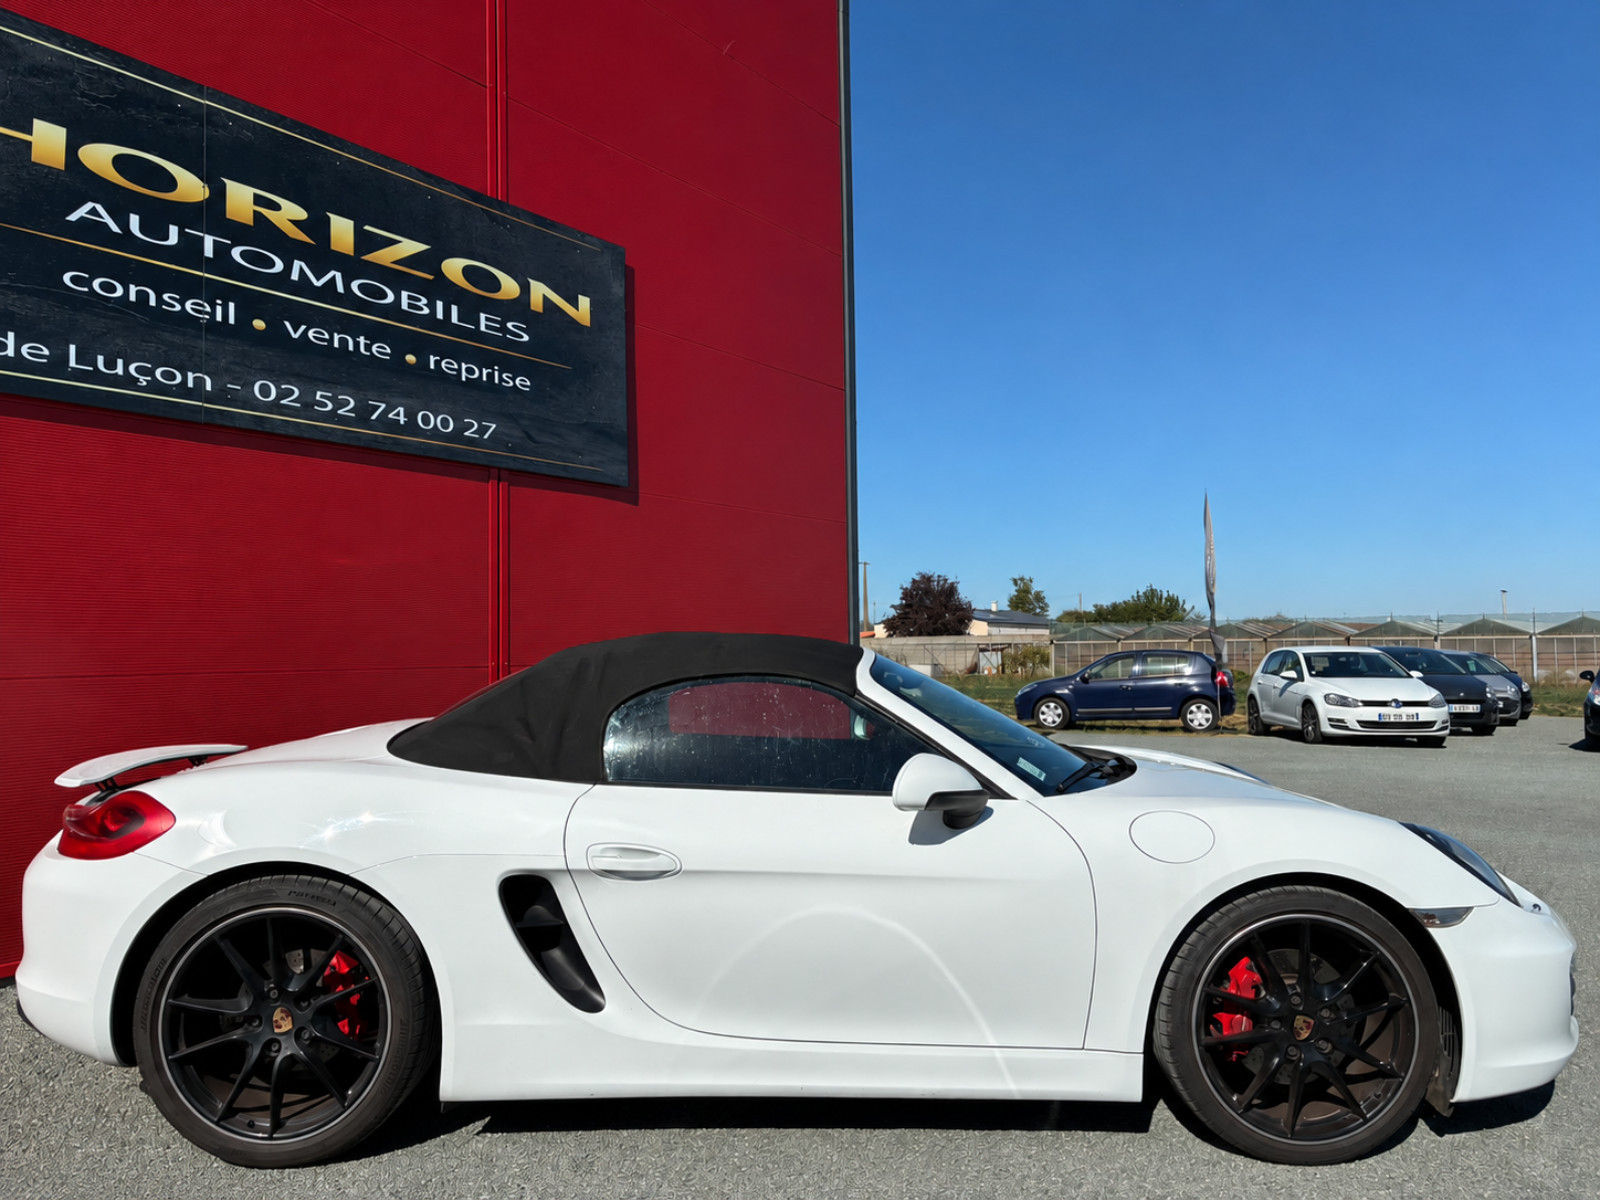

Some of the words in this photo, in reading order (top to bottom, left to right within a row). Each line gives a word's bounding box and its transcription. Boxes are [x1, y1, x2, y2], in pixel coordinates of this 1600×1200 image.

[62, 271, 235, 325] conseil
[283, 320, 392, 360] vente
[428, 353, 532, 392] reprise
[65, 201, 530, 342] AUTOMOBILES
[68, 343, 212, 392] Luçon
[253, 379, 301, 408] 02
[313, 390, 356, 417] 52
[368, 400, 408, 425] 74
[416, 410, 454, 433] 00
[463, 418, 497, 440] 27
